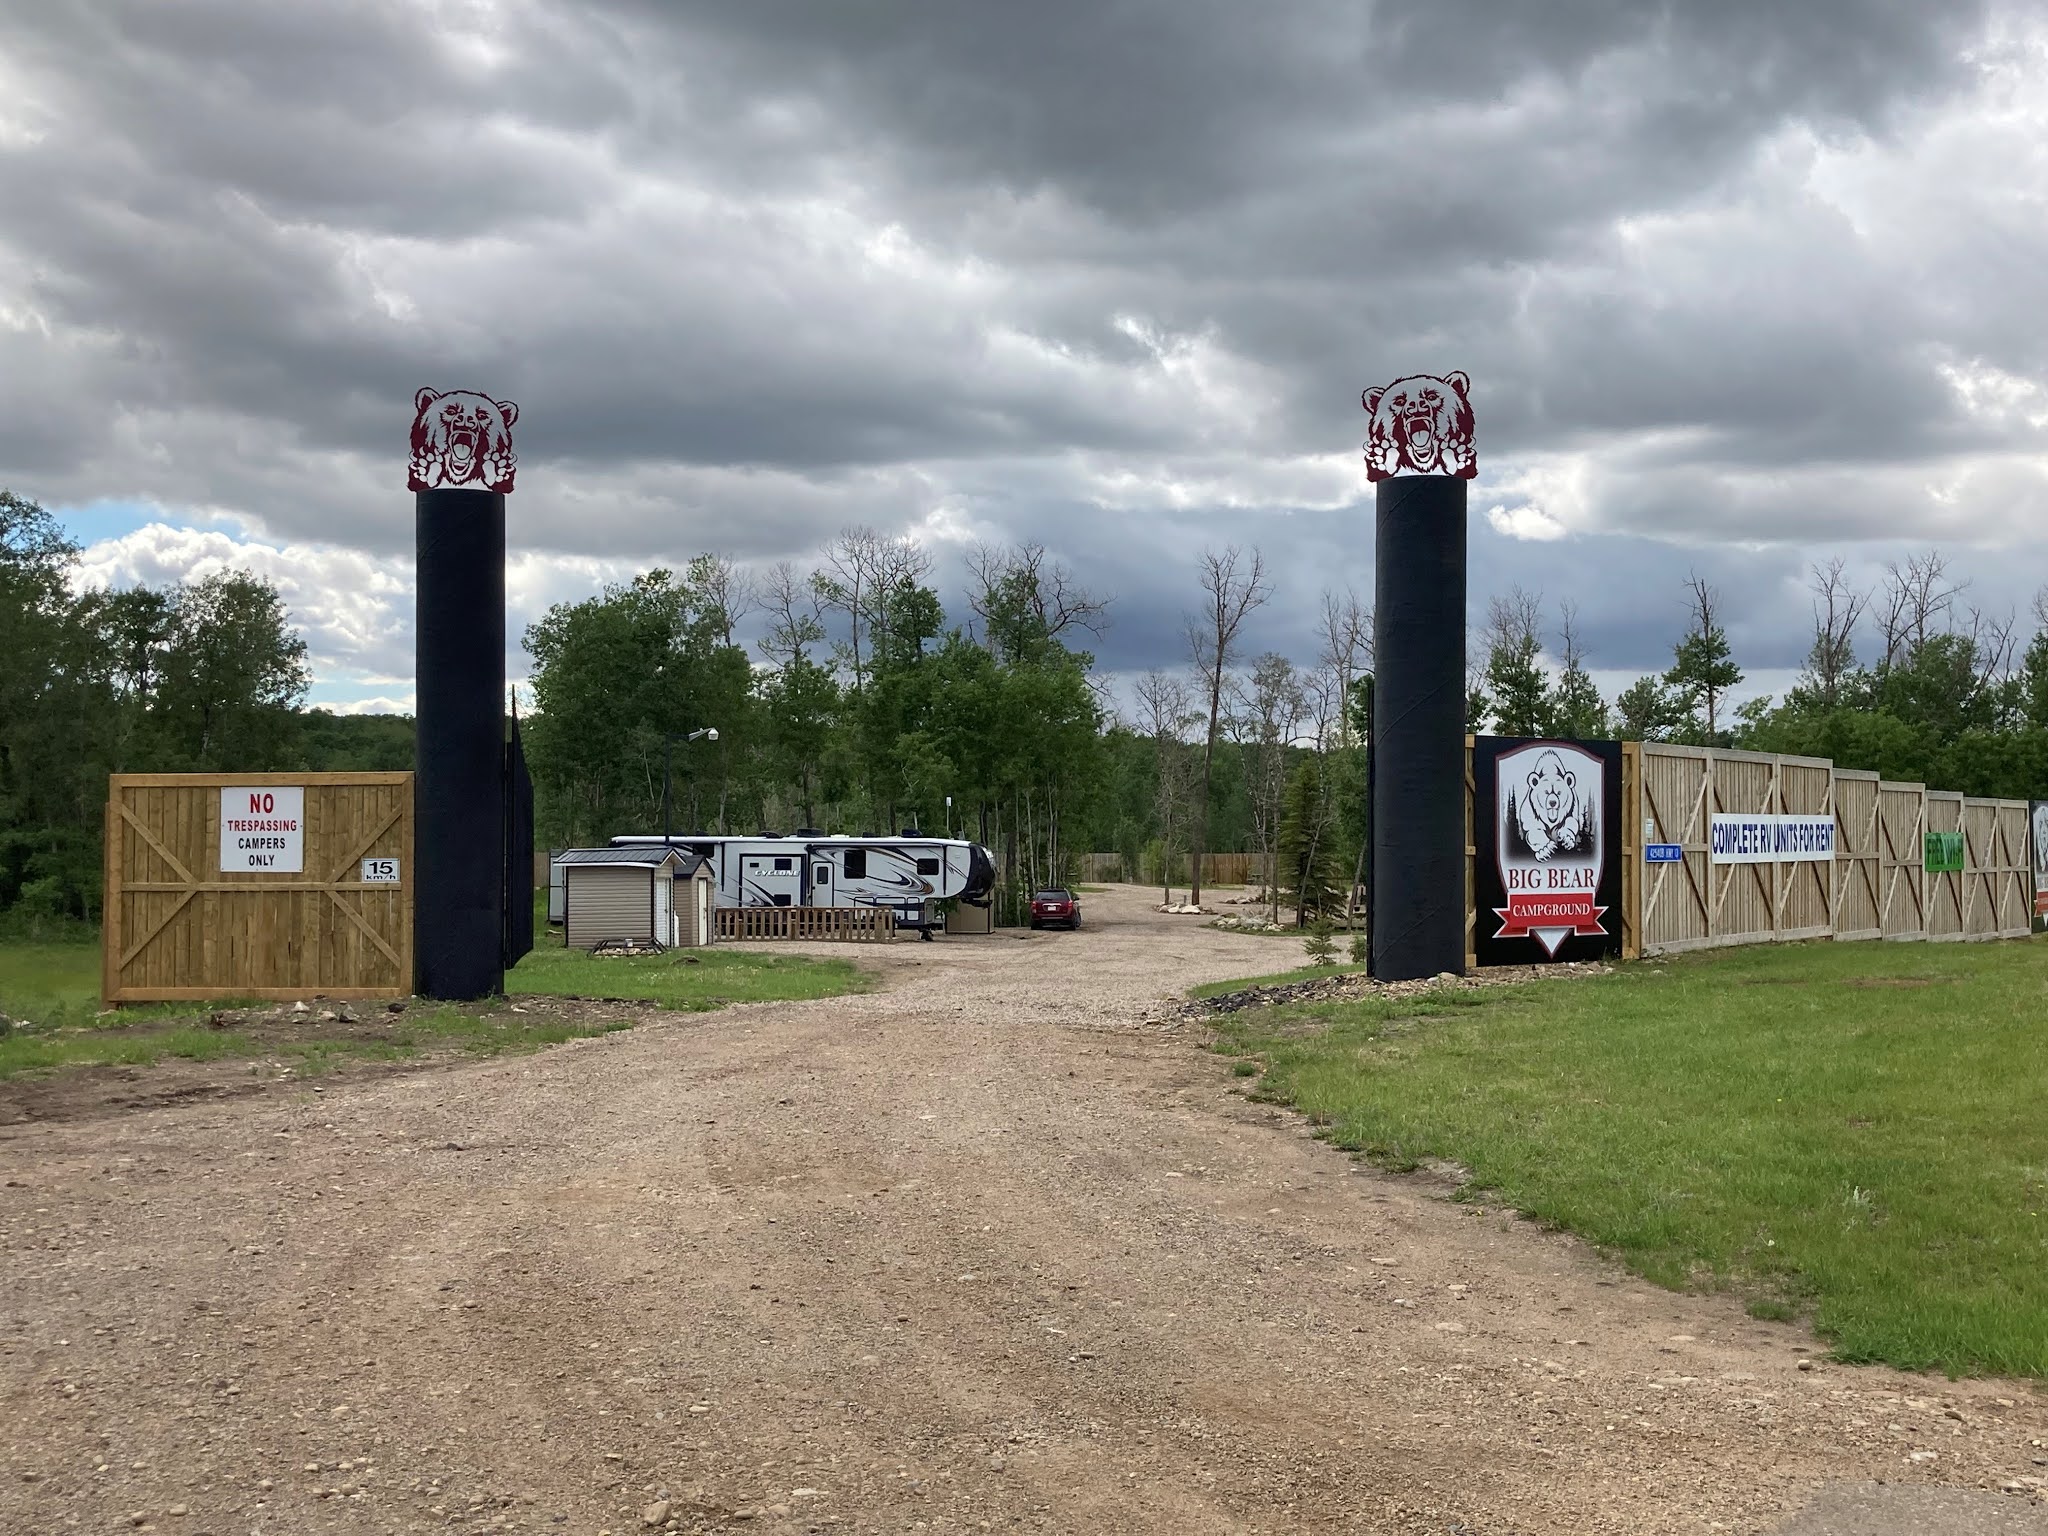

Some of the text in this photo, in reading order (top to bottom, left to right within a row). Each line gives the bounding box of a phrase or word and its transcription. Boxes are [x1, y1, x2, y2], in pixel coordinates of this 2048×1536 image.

[250, 793, 274, 814] NO
[228, 820, 297, 832] TRESPASSING
[238, 838, 286, 849] CAMPERS
[1712, 823, 1834, 854] COMPLETE RV UNITS FOR RENT
[249, 855, 275, 866] ONLY
[369, 862, 393, 875] 15
[1508, 868, 1595, 889] BIG BEAR
[1513, 903, 1590, 917] CAMPGROUND
